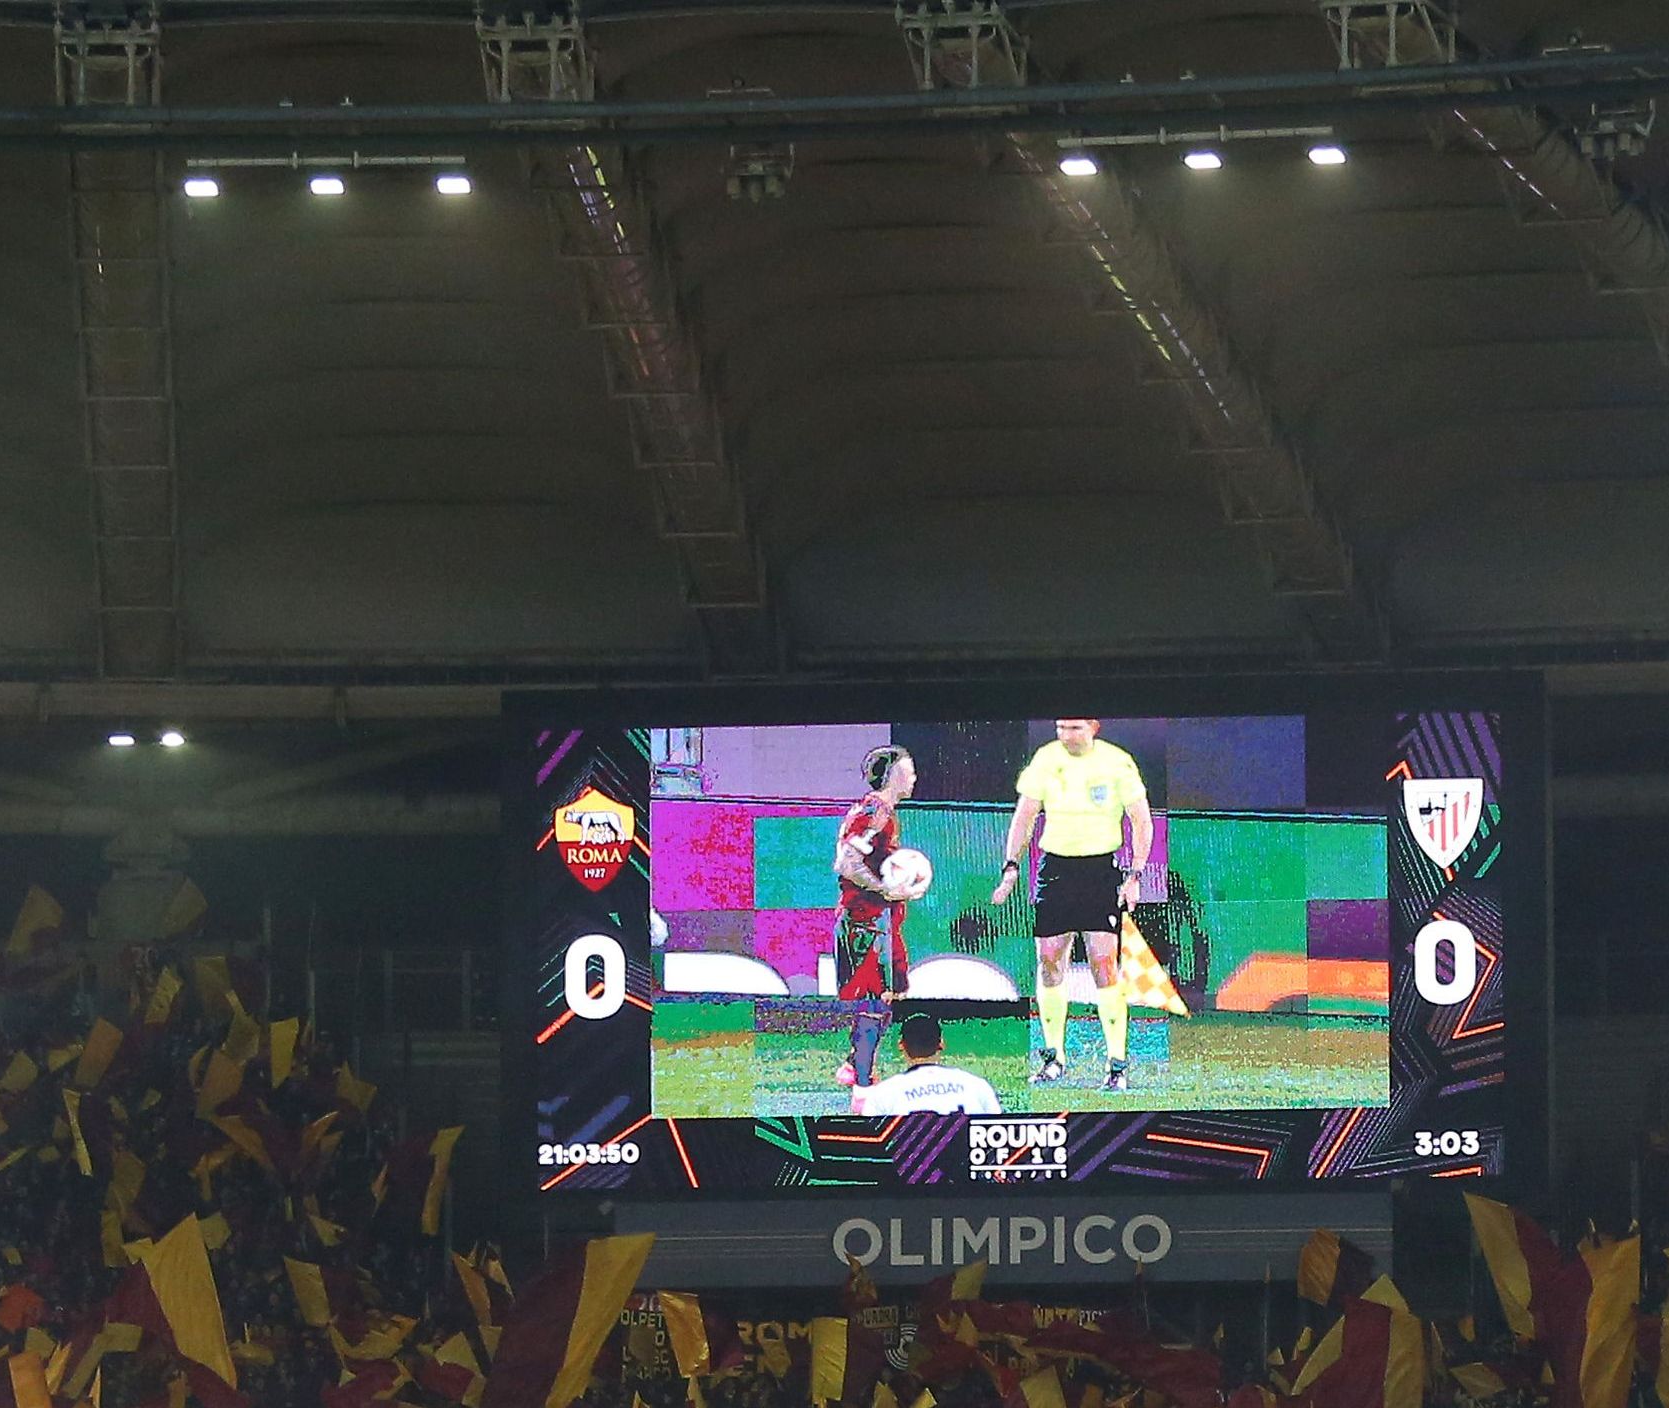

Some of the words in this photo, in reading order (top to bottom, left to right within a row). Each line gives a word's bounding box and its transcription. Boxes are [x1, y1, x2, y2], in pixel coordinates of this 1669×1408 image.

[566, 847, 624, 864] ROMA
[584, 867, 606, 879] 1927
[1414, 920, 1477, 1005] 0
[564, 933, 627, 1019] 0
[969, 1124, 1068, 1149] ROUND
[1414, 1131, 1480, 1156] 3:03
[538, 1143, 640, 1165] 21:03:50
[970, 1147, 1009, 1165] OF
[832, 1214, 1173, 1268] OLIMPICO
